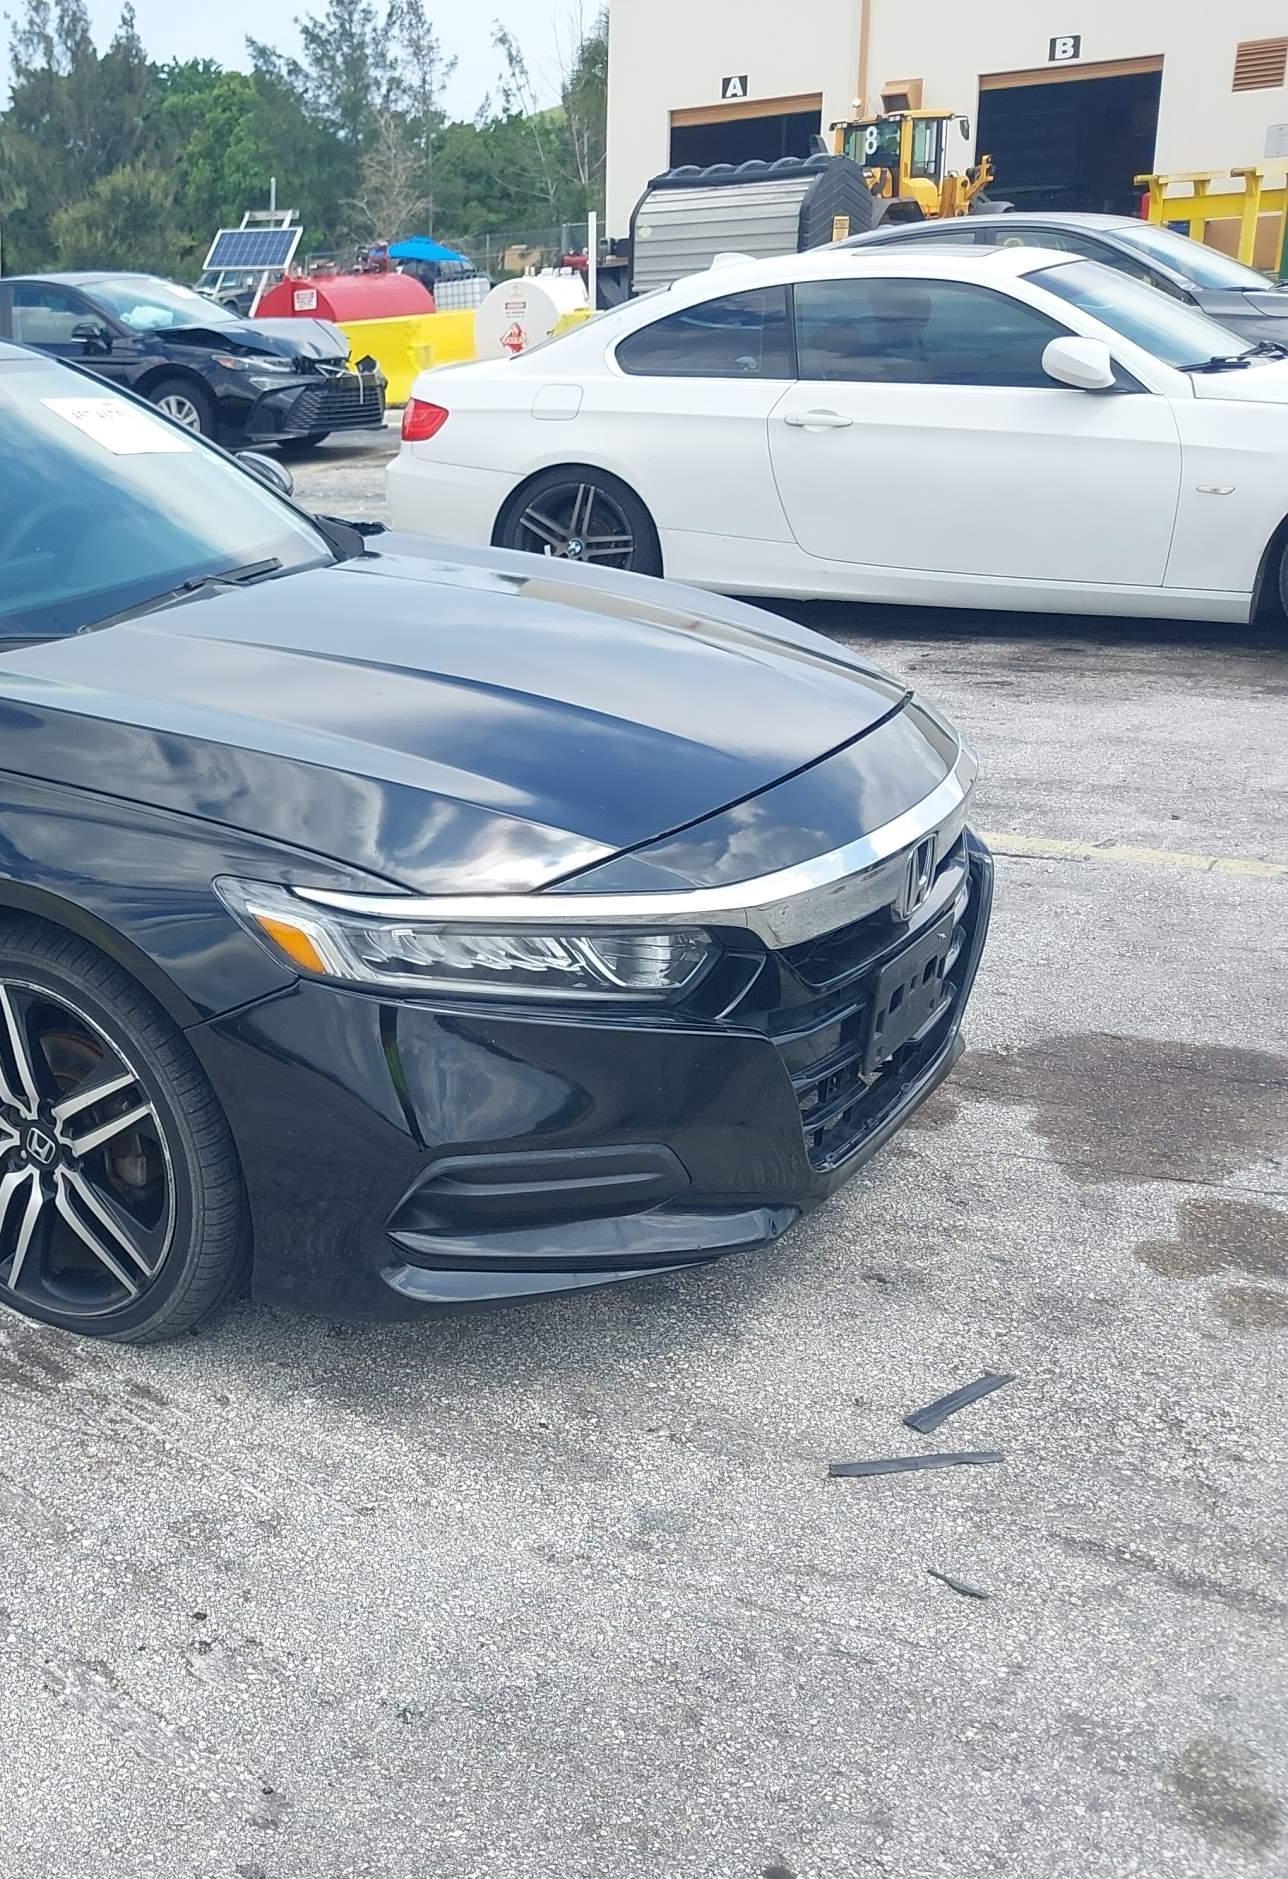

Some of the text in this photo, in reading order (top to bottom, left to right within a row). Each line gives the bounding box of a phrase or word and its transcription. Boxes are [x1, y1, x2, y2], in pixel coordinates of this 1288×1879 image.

[1055, 38, 1074, 60] B
[725, 77, 743, 97] A
[865, 126, 878, 155] 8
